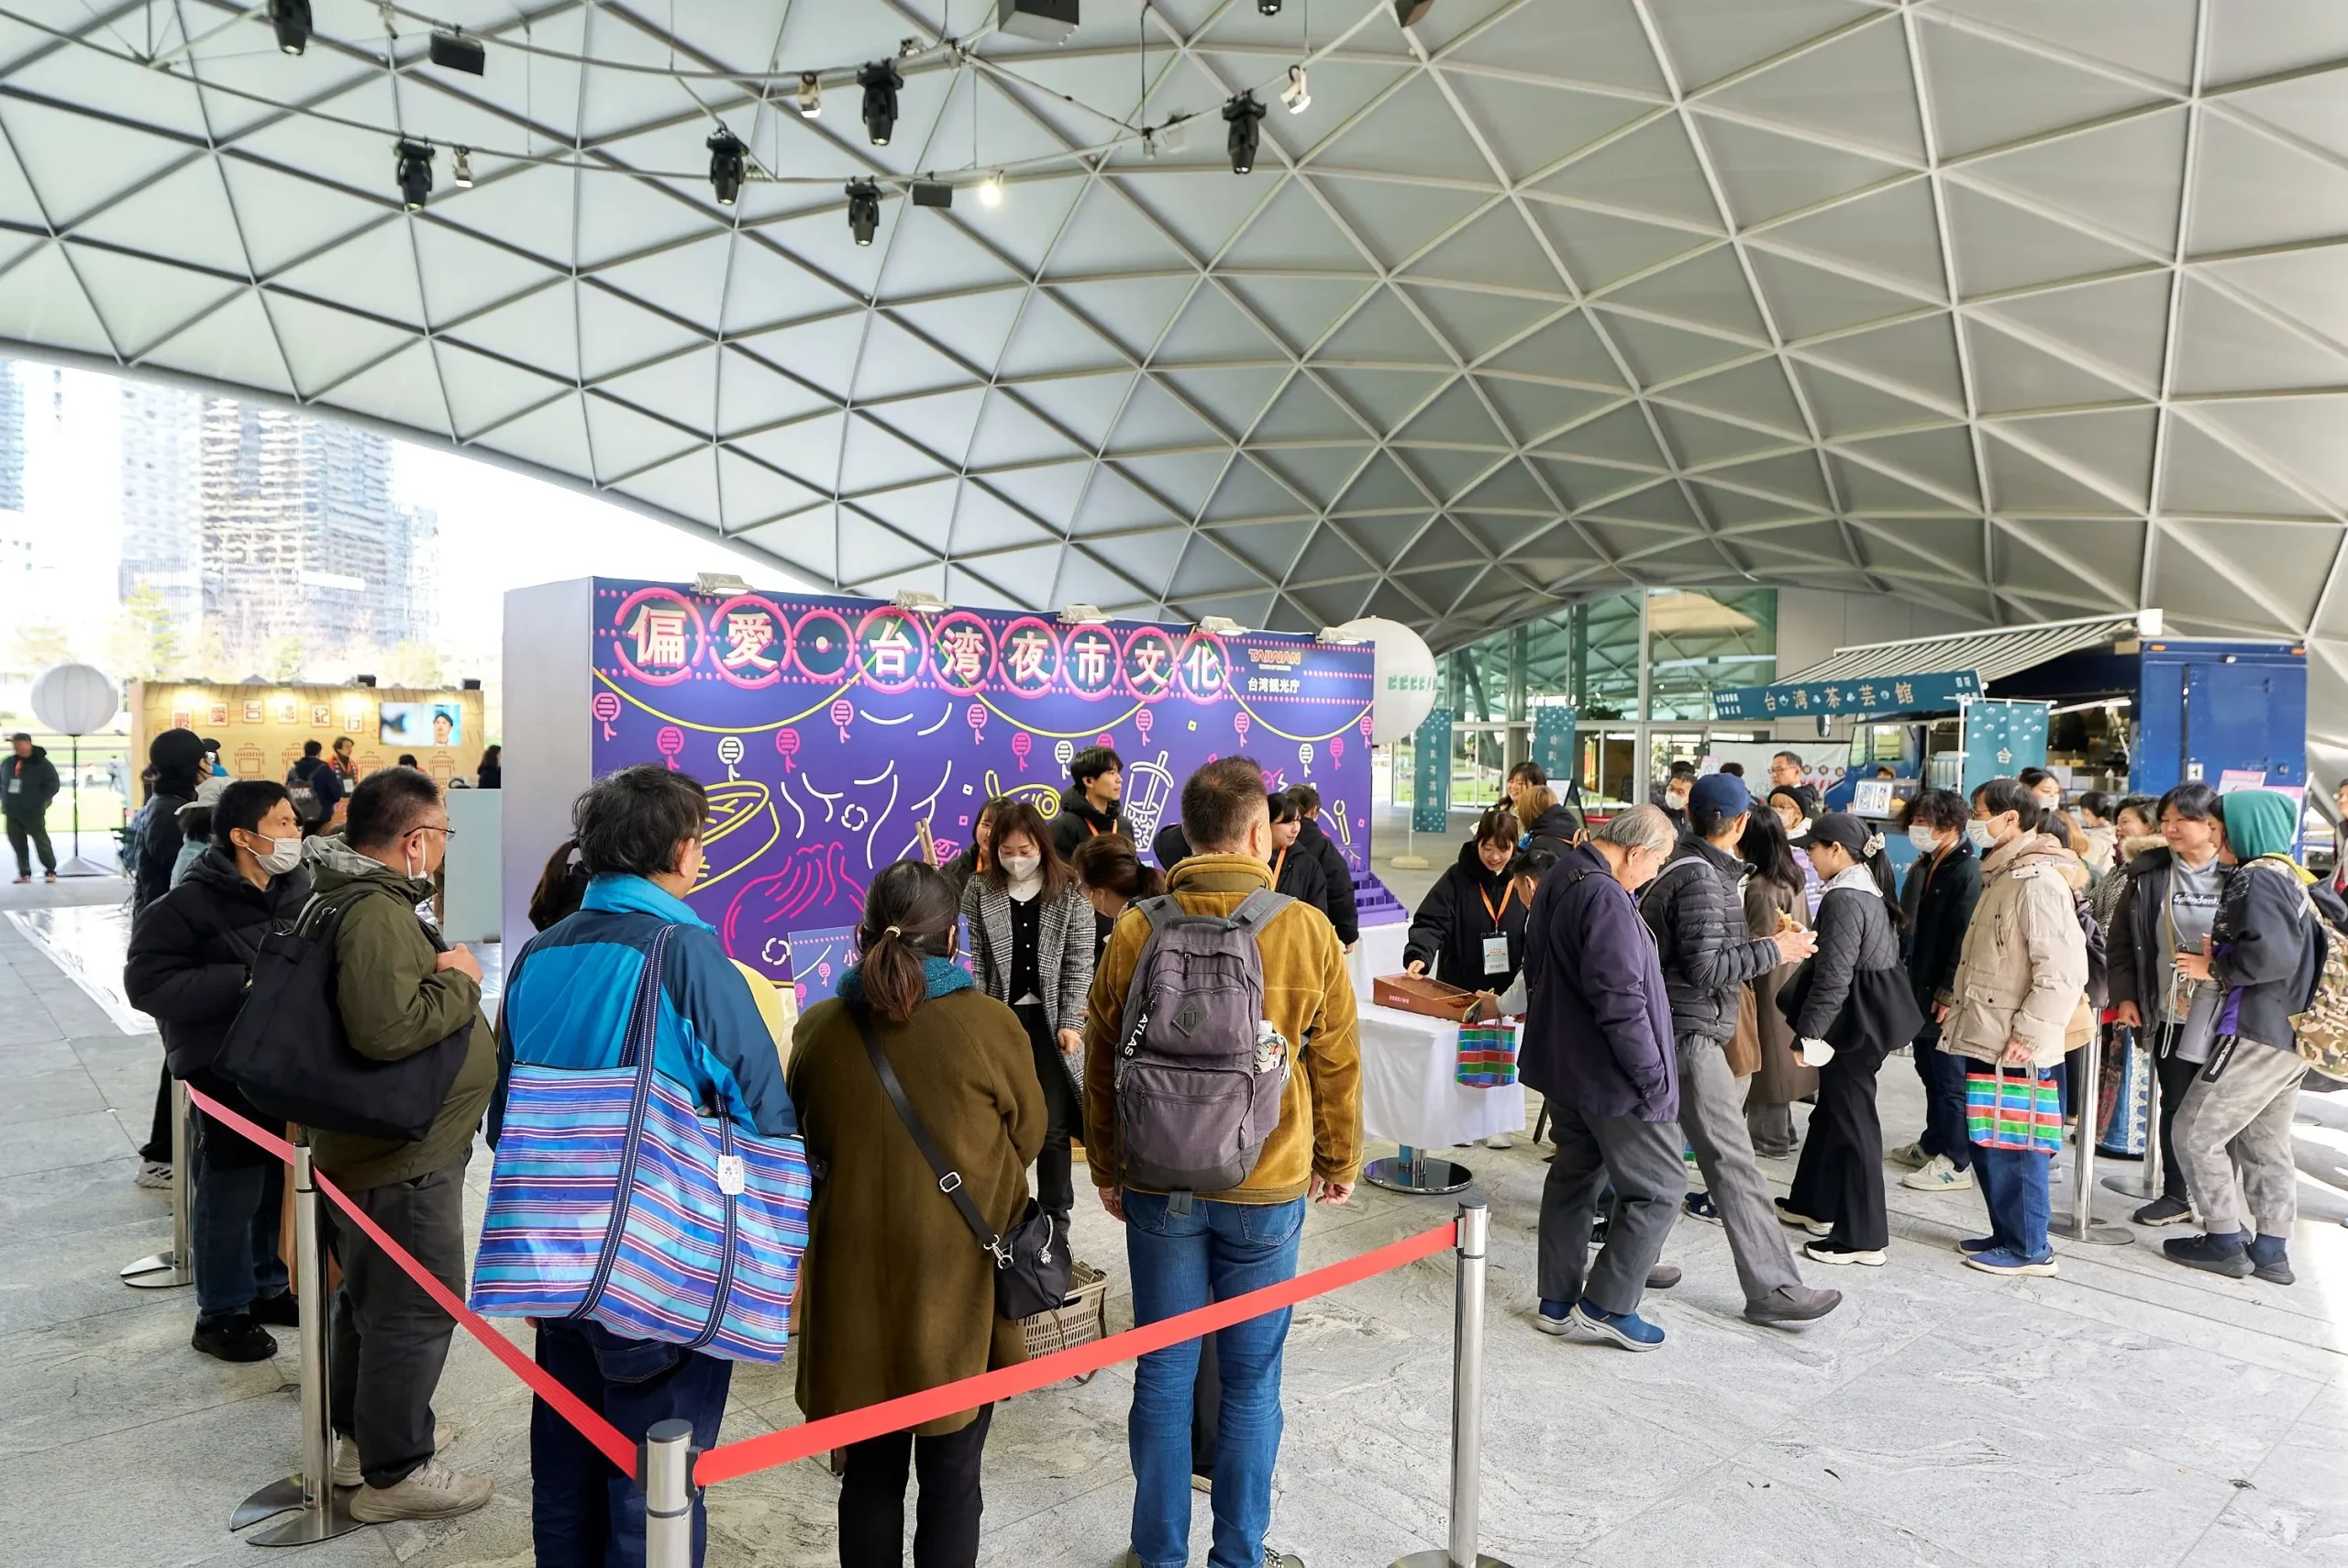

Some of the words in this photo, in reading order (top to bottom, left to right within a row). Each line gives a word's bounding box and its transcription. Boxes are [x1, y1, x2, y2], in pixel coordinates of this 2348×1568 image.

[1248, 648, 1301, 665] TAIWAN
[1248, 677, 1301, 693] 台湾観光庁
[1764, 681, 1914, 712] 台湾茶芸館
[1124, 1013, 1148, 1056] ATLAS
